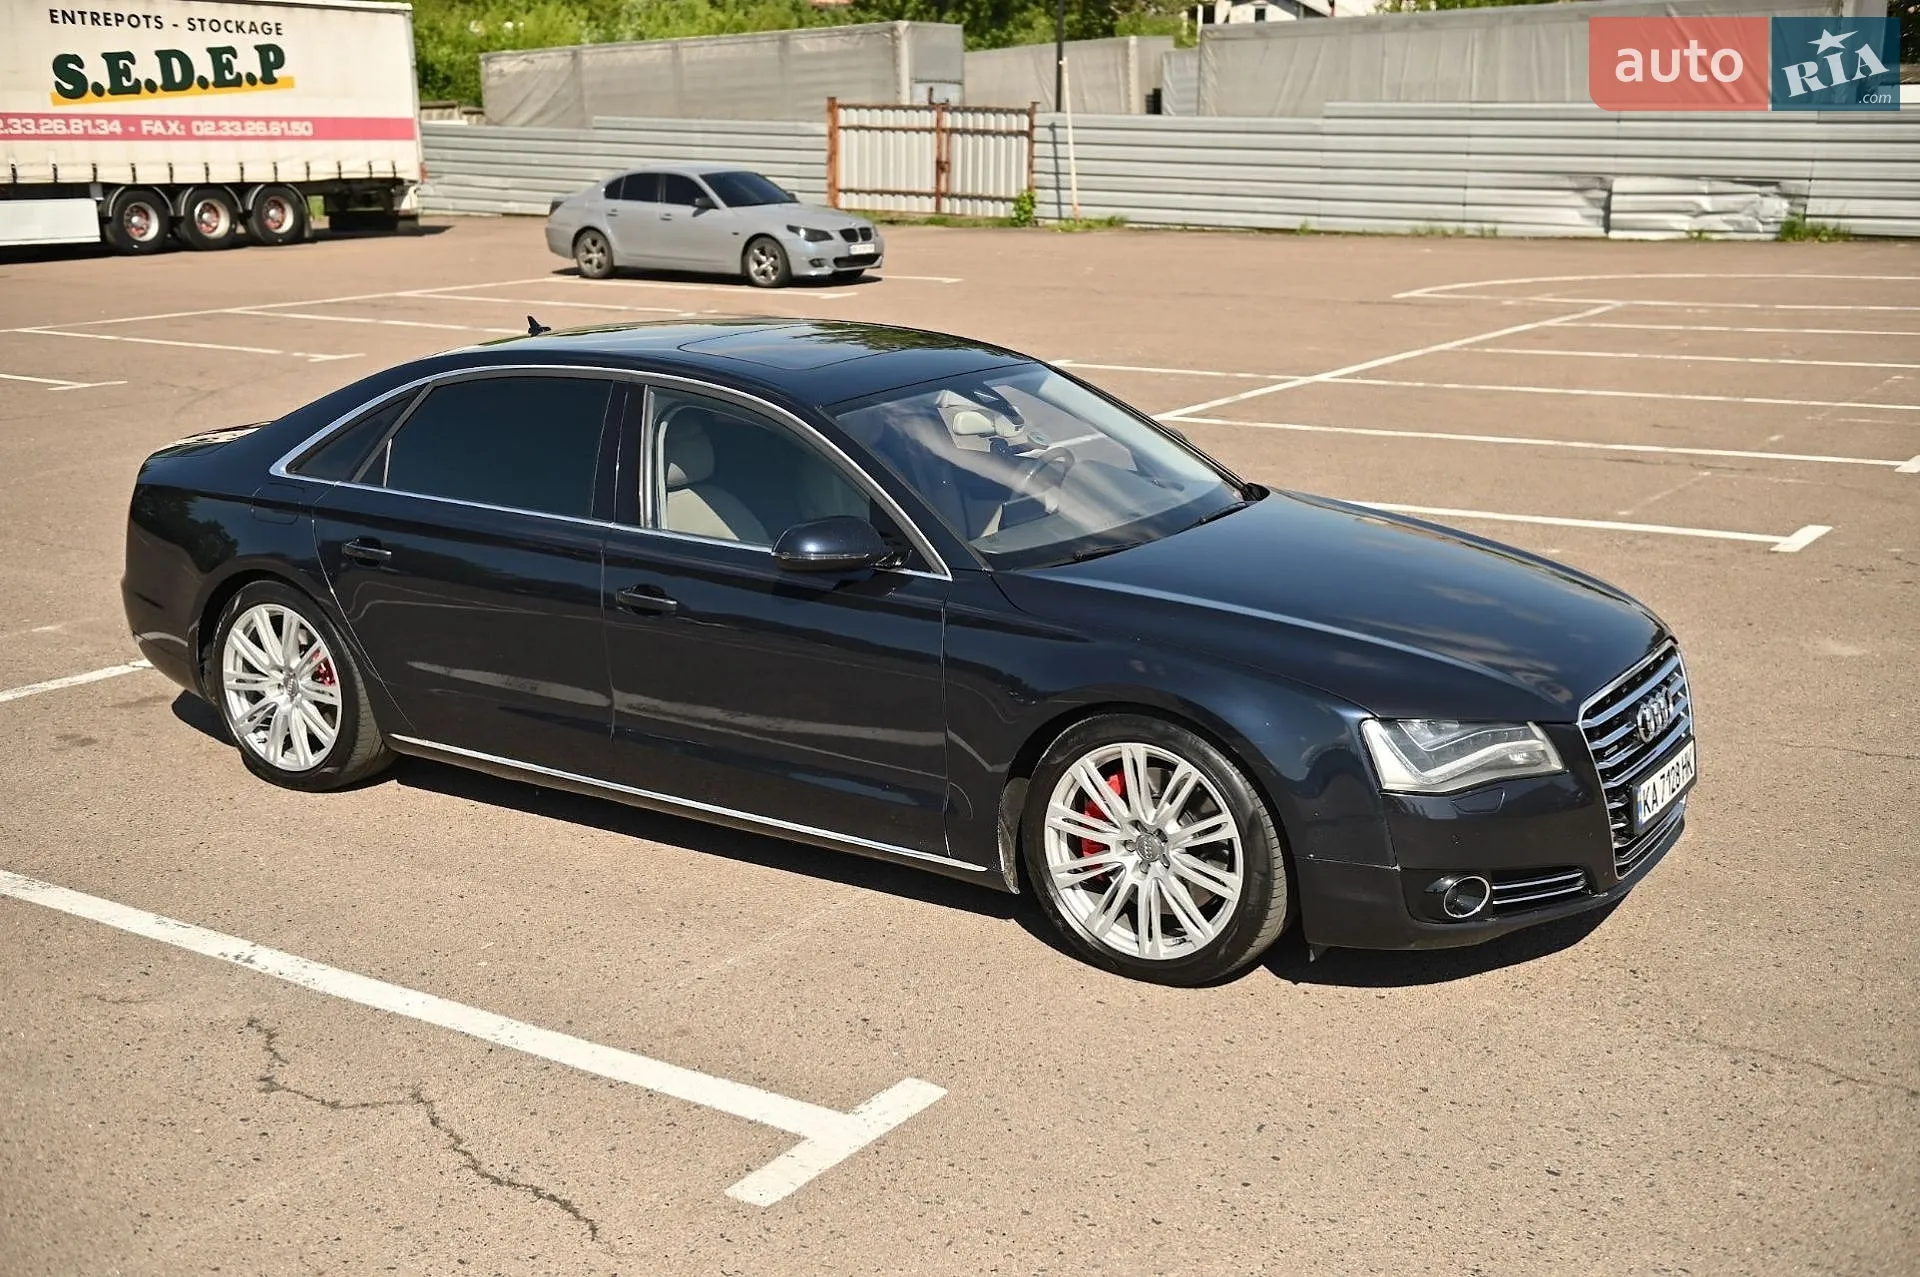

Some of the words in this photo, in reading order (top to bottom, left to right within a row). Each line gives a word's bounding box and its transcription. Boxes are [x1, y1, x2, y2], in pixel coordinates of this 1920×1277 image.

[49, 9, 163, 30] ENTREPOTS
[187, 18, 283, 35] STOCKAGE
[52, 43, 285, 100] S.E.D.E.P
[142, 119, 186, 135] FAX:
[1643, 782, 1659, 817] KA
[1660, 762, 1681, 803] 7128
[1681, 748, 1693, 783] HK
